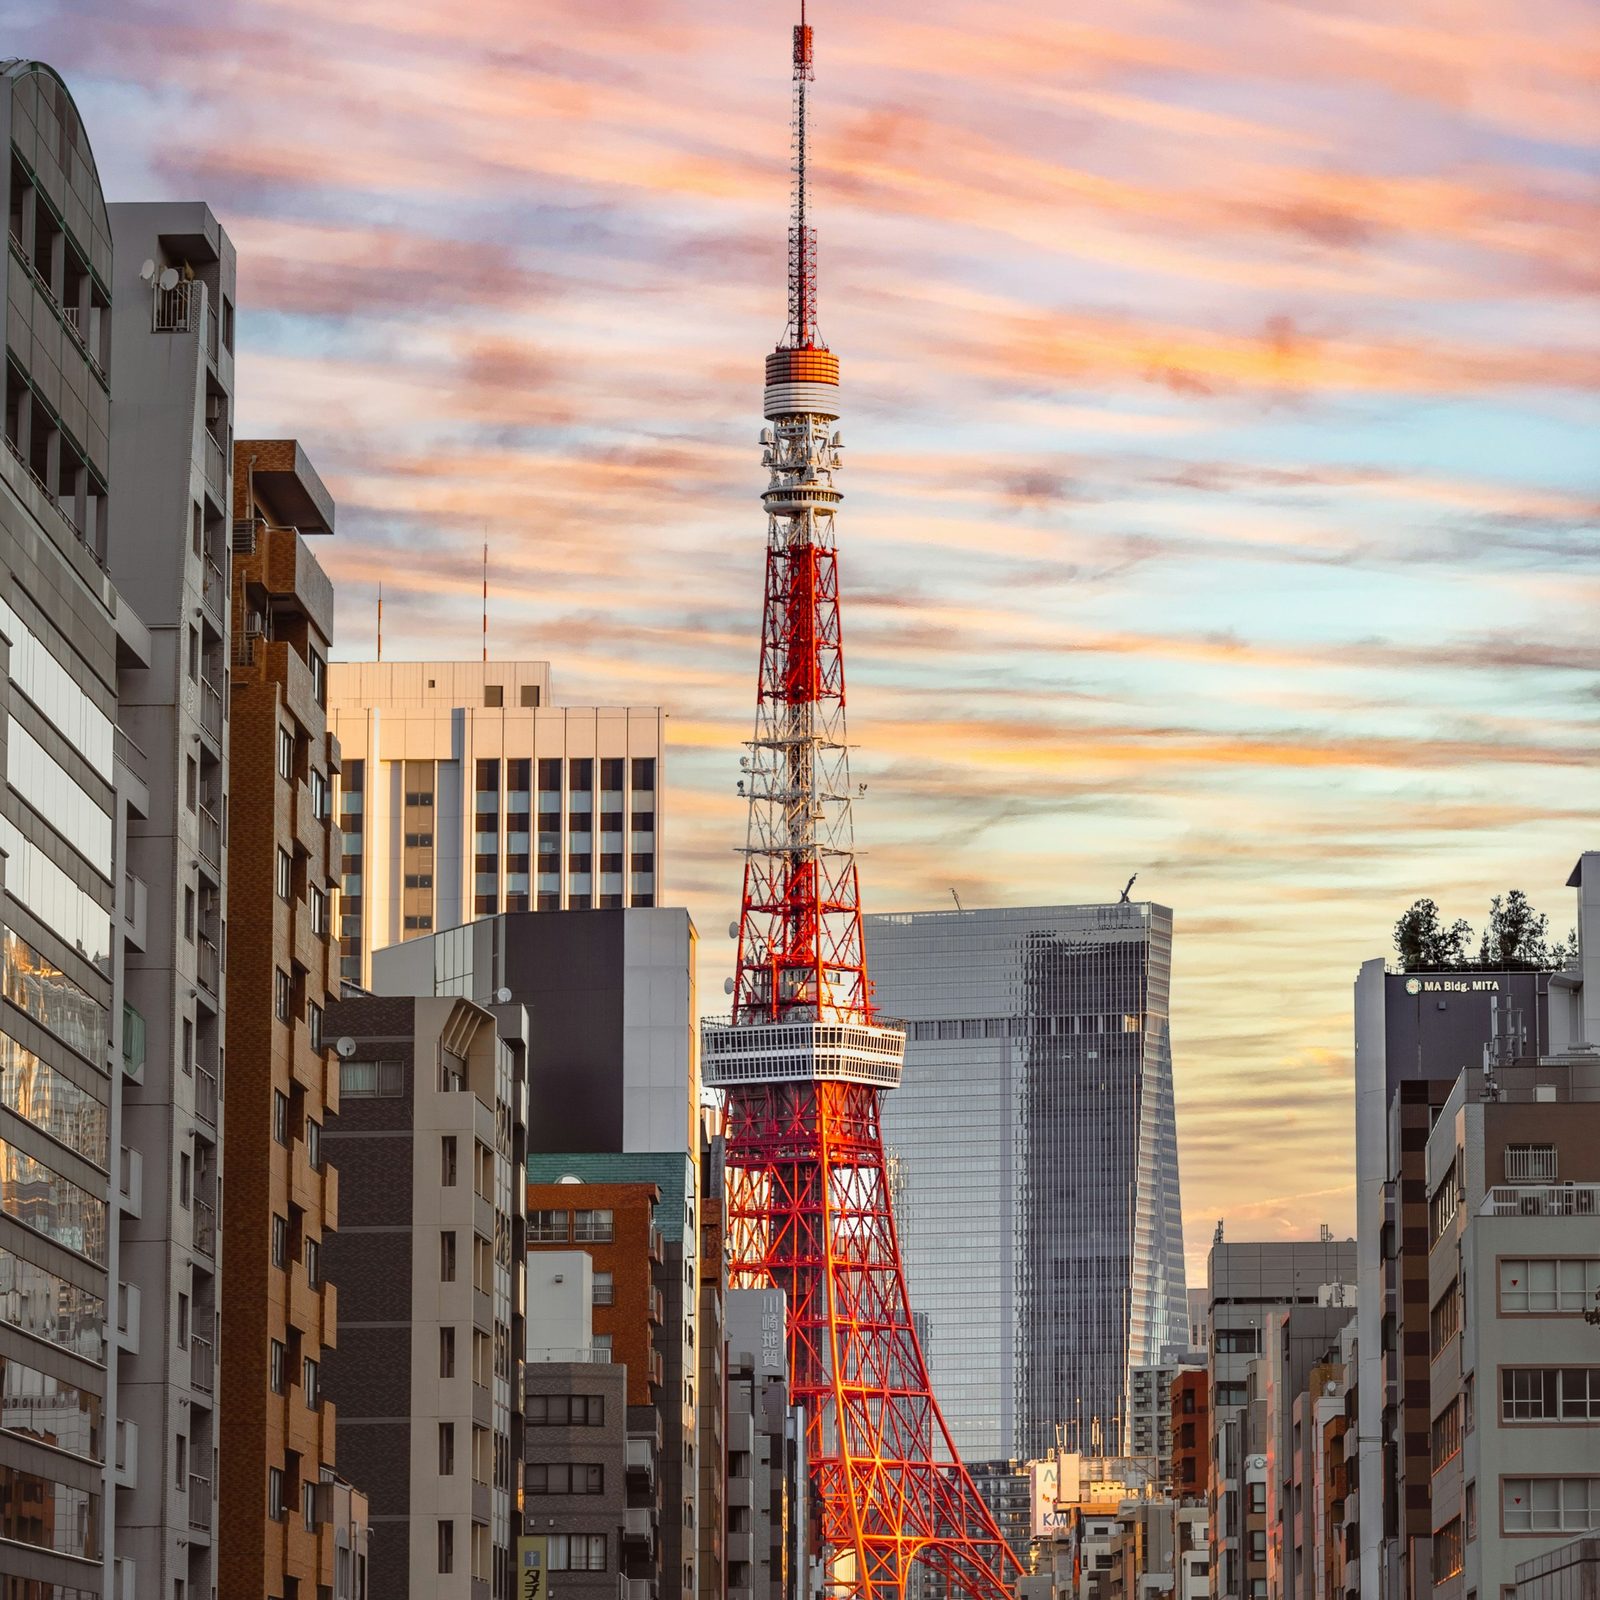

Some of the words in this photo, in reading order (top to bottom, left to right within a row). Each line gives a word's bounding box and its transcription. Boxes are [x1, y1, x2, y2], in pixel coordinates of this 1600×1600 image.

[1424, 981, 1441, 991] MA
[1444, 981, 1470, 992] Bldg.
[1472, 981, 1499, 991] MITA
[761, 1295, 780, 1368] 川崎地質
[524, 1569, 540, 1600] タチ
